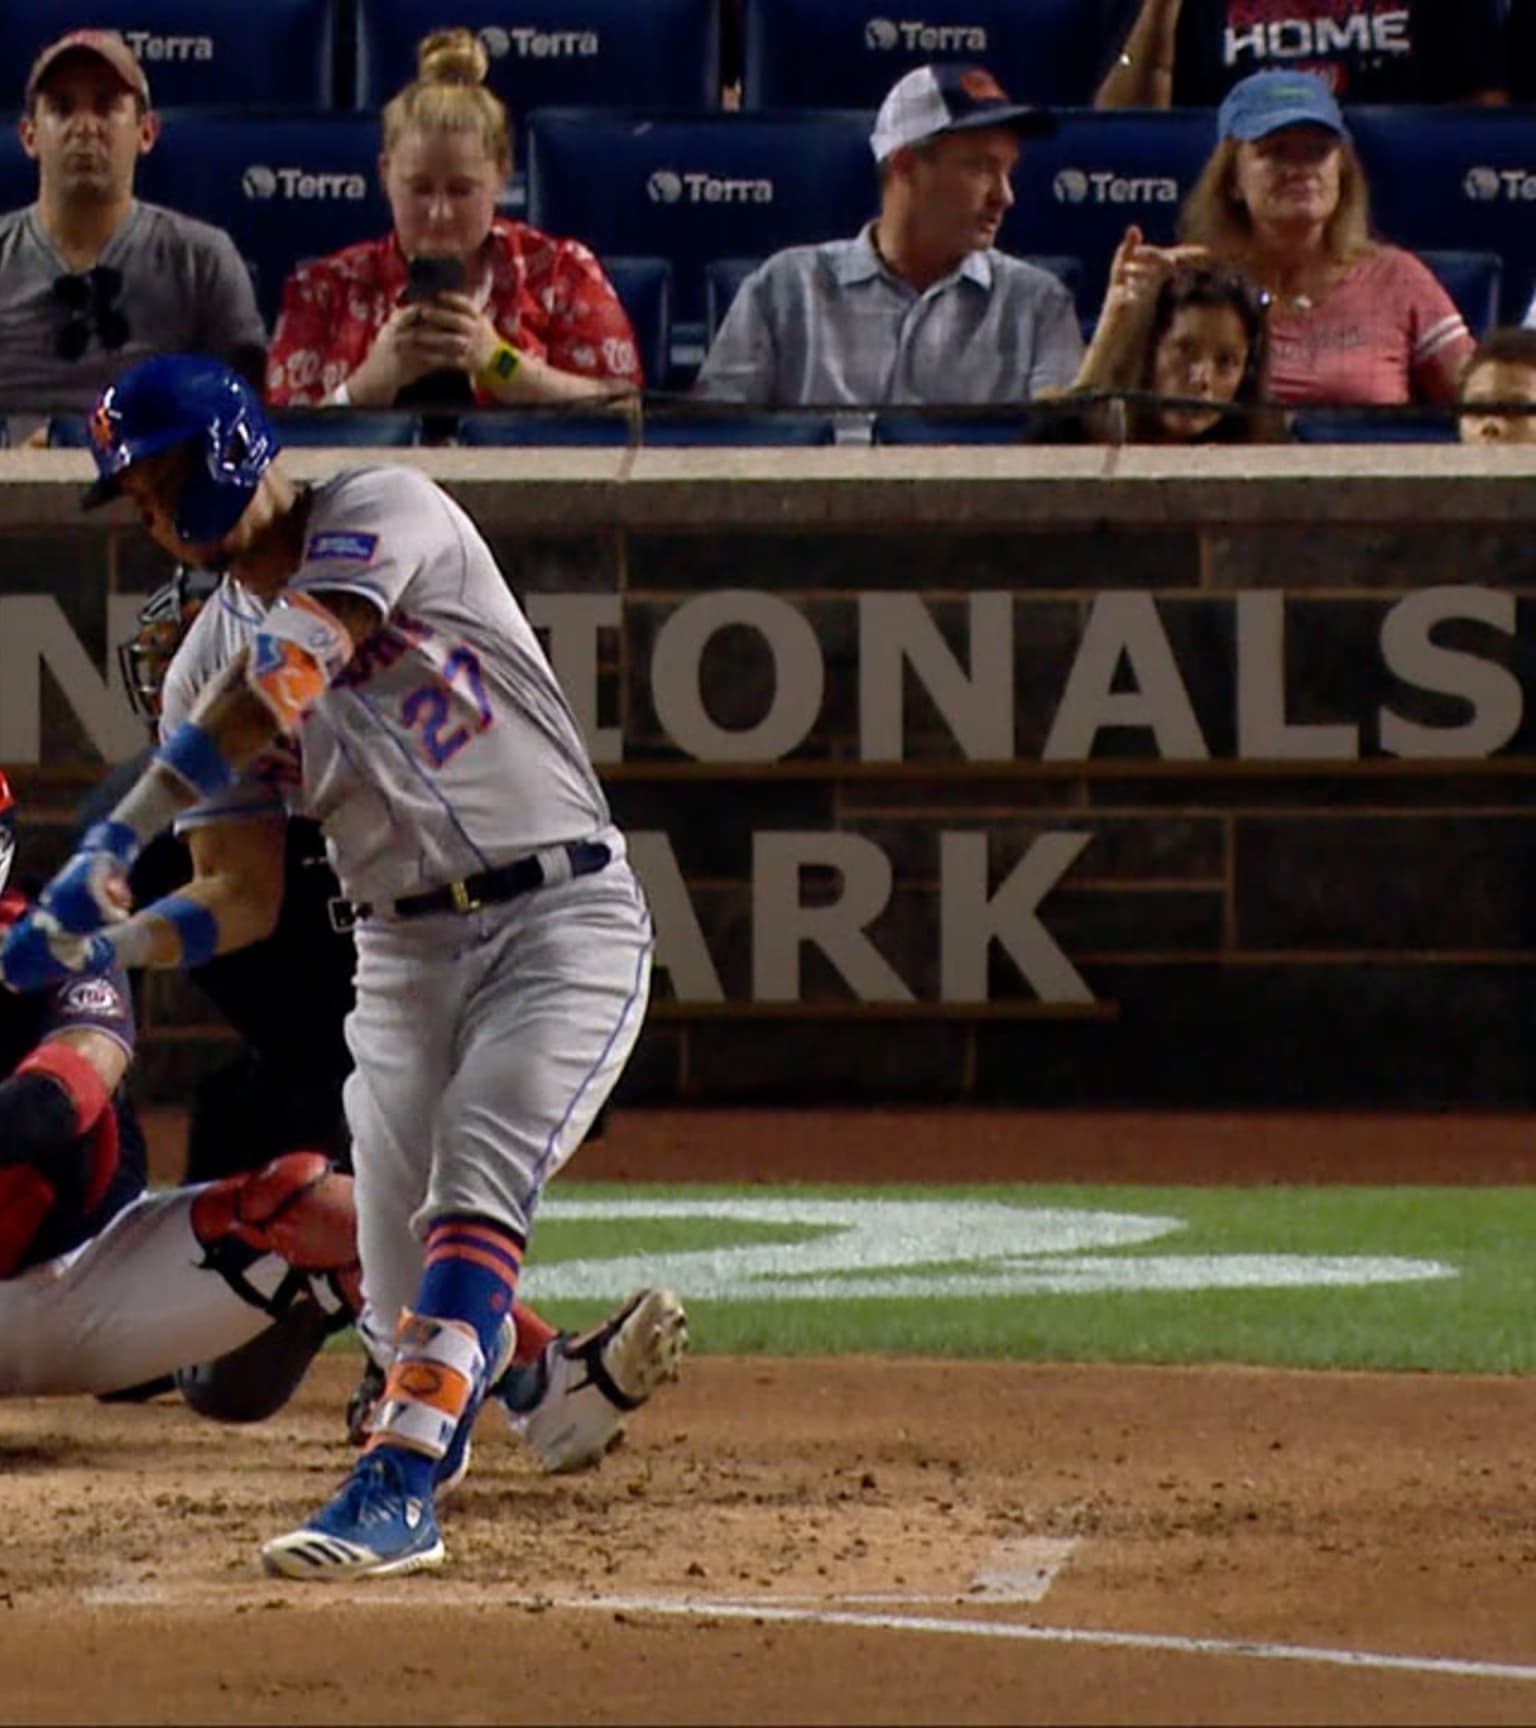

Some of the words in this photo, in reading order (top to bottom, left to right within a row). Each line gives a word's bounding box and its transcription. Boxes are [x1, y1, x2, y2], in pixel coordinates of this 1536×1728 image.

[126, 32, 213, 60] Terra
[512, 28, 598, 57] Terra
[900, 22, 987, 50] Terra
[1223, 10, 1411, 66] HOME
[278, 169, 365, 199] Terra
[684, 173, 773, 203] Terra
[1090, 173, 1178, 202] Terra
[400, 642, 493, 769] 27
[624, 830, 1096, 1003] ARK
